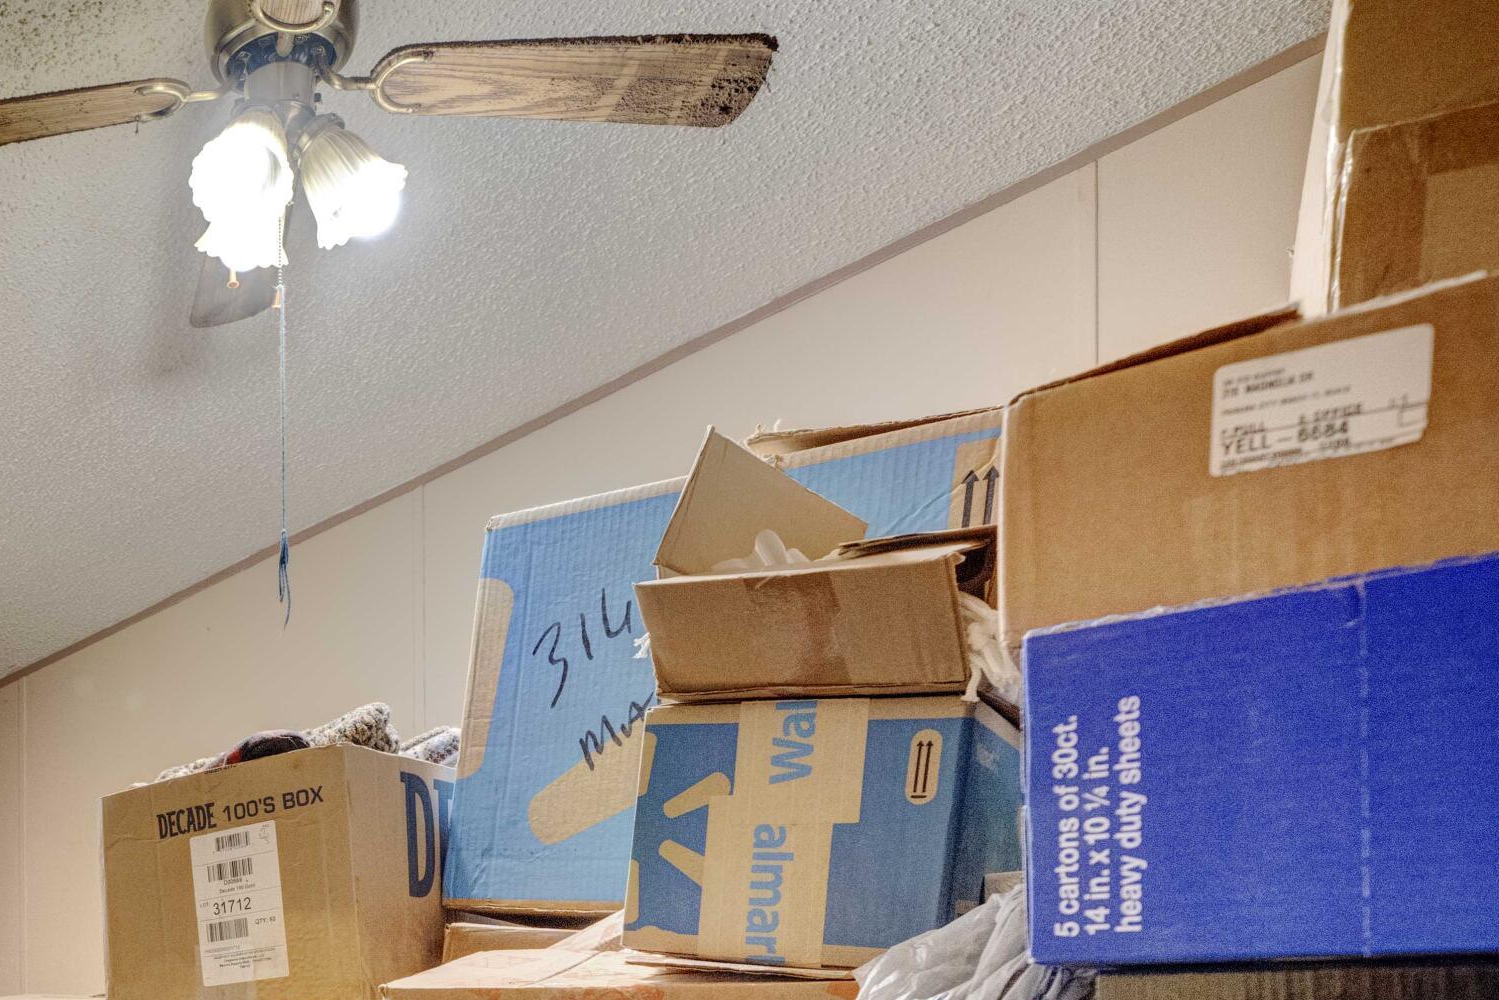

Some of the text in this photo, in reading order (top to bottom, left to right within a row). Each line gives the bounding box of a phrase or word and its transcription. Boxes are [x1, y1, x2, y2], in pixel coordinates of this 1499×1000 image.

[1222, 435, 1271, 455] YELL
[156, 786, 325, 840] DECADE 100'S BOX
[1051, 714, 1081, 938] 5 cartons of 30ct.
[1082, 747, 1111, 936] 14 in. x 10 in.
[1112, 695, 1149, 934] heavy duty sheets
[213, 897, 251, 915] 31712
